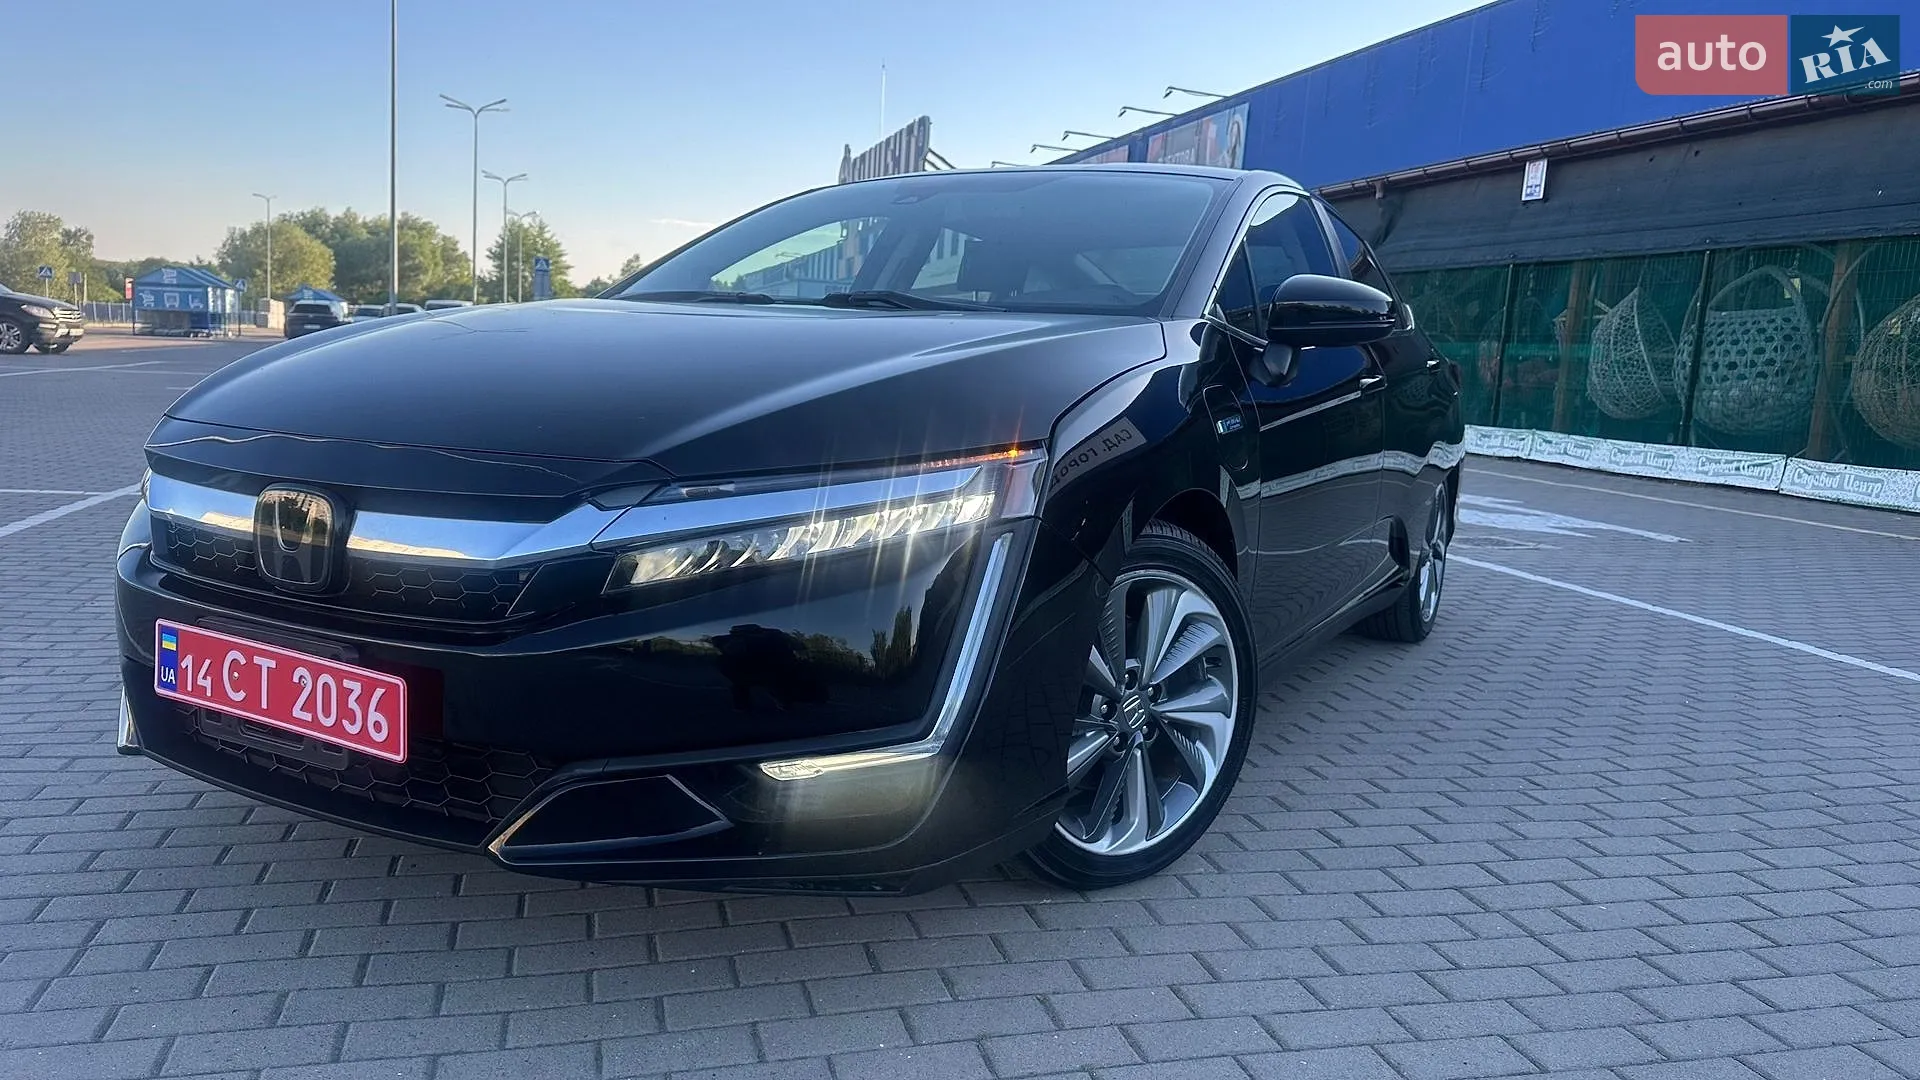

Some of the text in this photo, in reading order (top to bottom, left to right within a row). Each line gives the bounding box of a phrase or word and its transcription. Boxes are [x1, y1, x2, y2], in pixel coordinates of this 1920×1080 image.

[1843, 473, 1883, 498] Центр
[160, 666, 175, 685] UA
[180, 654, 212, 697] 14
[291, 666, 389, 743] 2036
